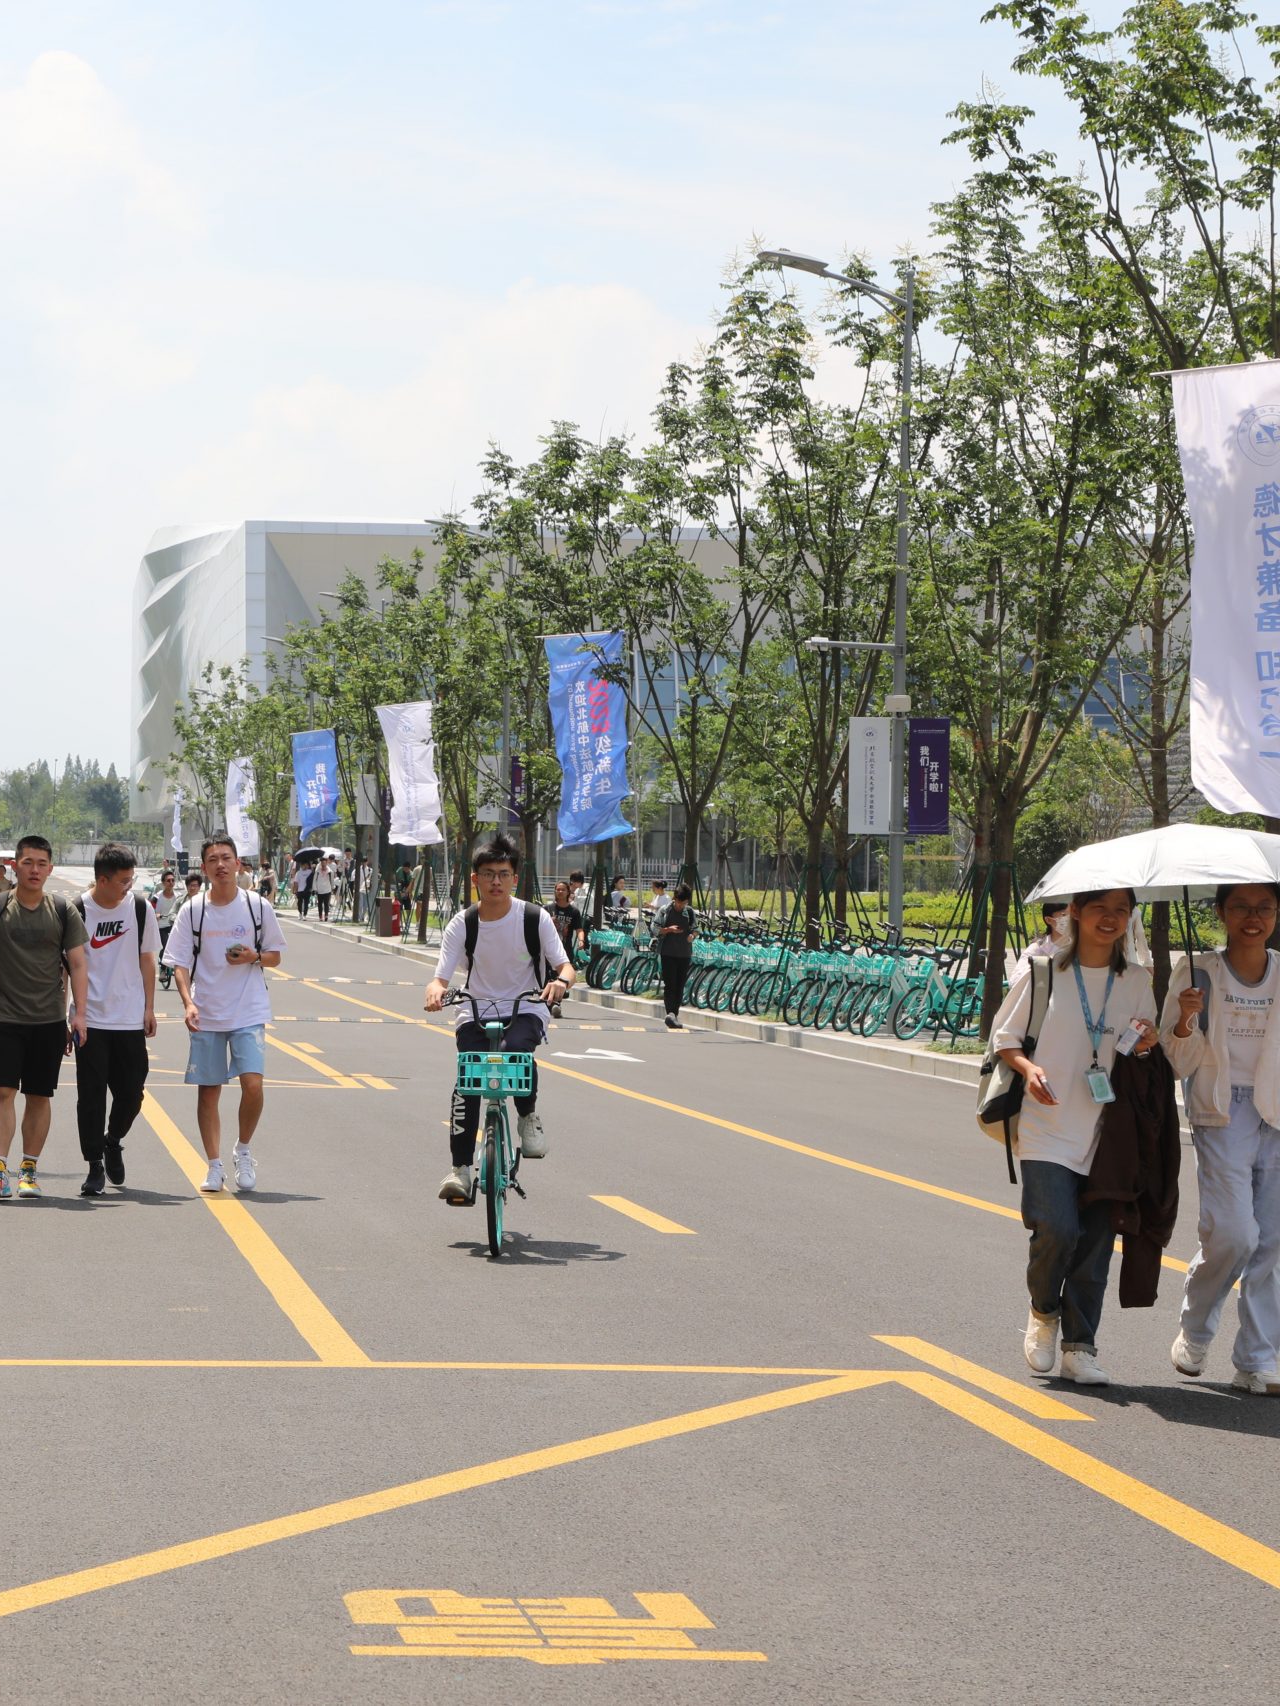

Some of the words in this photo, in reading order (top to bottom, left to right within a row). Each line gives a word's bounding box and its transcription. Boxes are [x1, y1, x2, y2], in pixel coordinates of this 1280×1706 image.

[919, 745, 930, 766] 我们
[95, 919, 125, 938] NIKE
[452, 1090, 466, 1136] AULA
